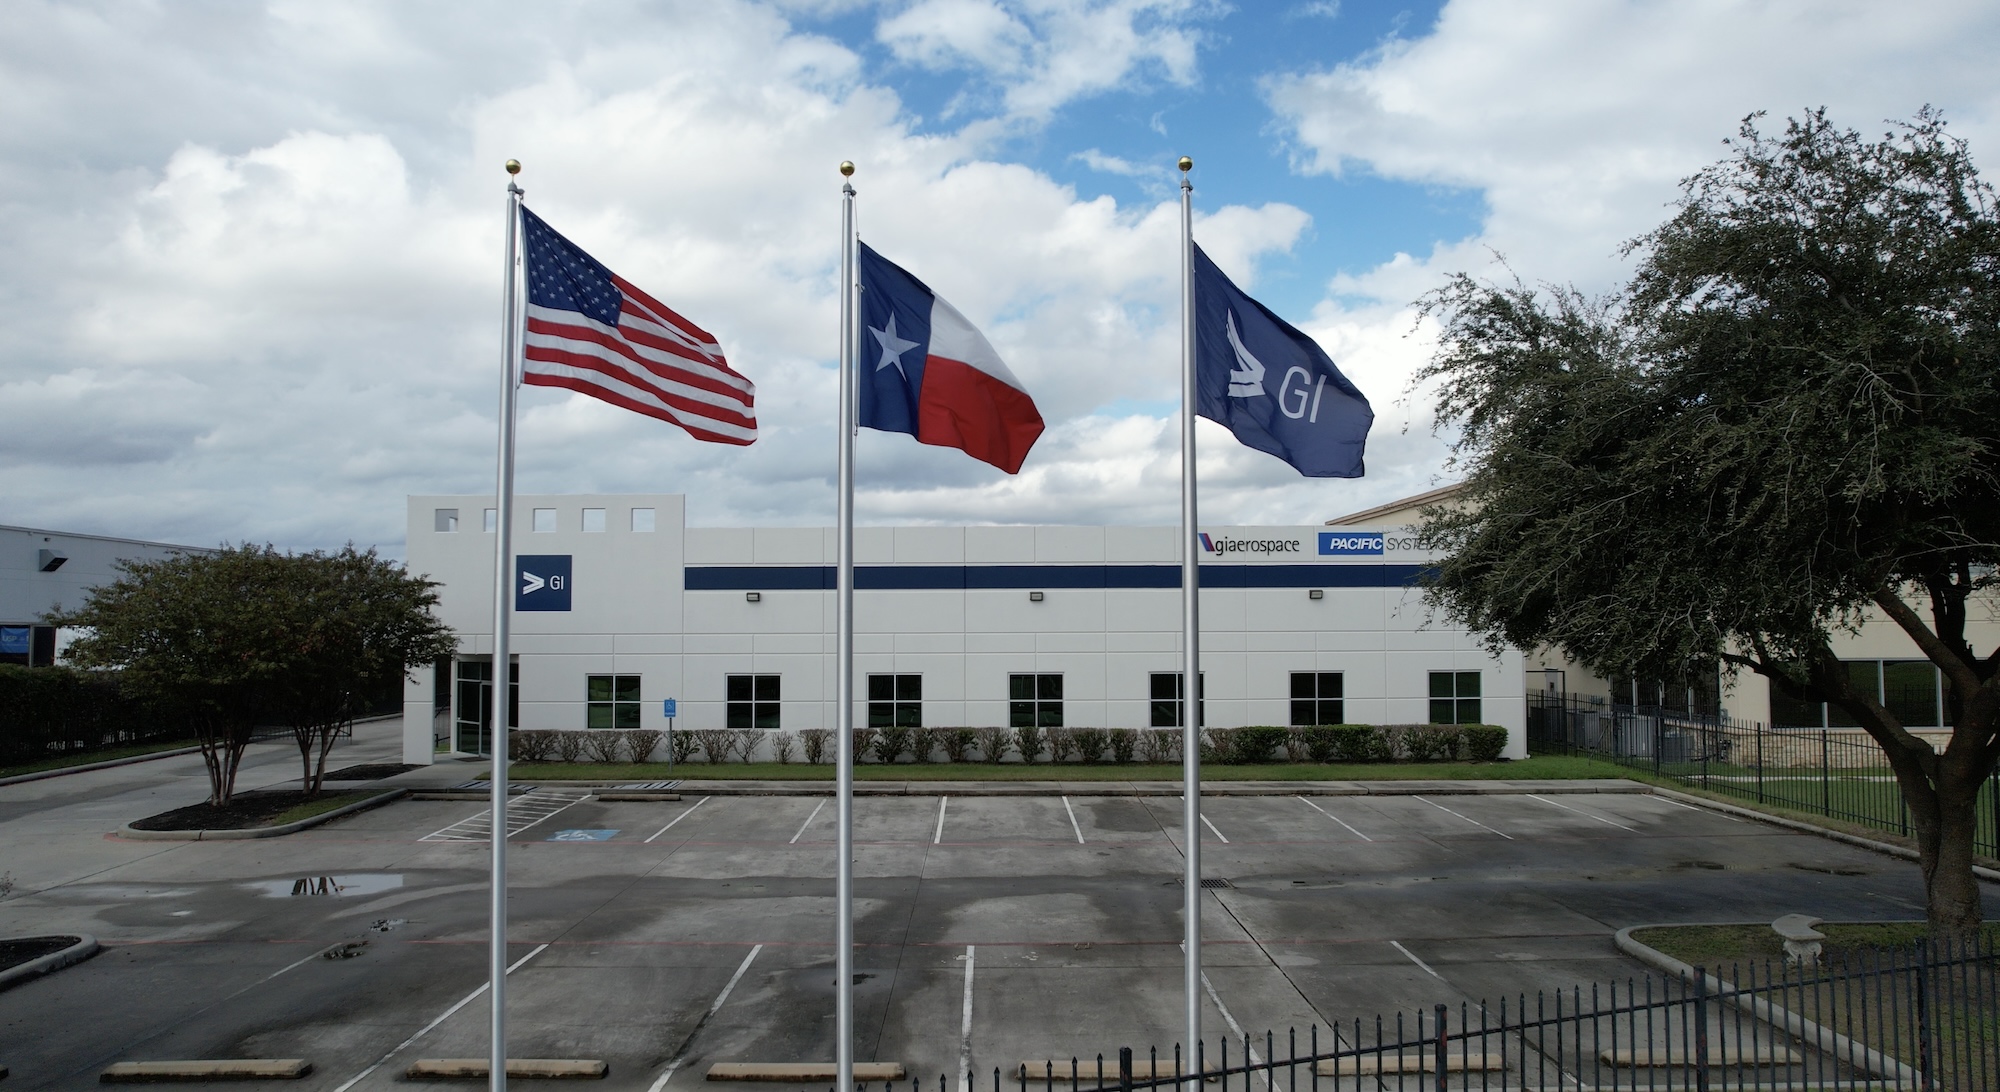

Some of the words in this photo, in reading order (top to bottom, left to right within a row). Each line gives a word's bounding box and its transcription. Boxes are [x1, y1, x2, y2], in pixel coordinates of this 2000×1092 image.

[1278, 365, 1327, 423] GI
[1215, 536, 1299, 556] giaerospace
[1330, 537, 1383, 550] PACIFIC
[549, 575, 565, 590] GI
